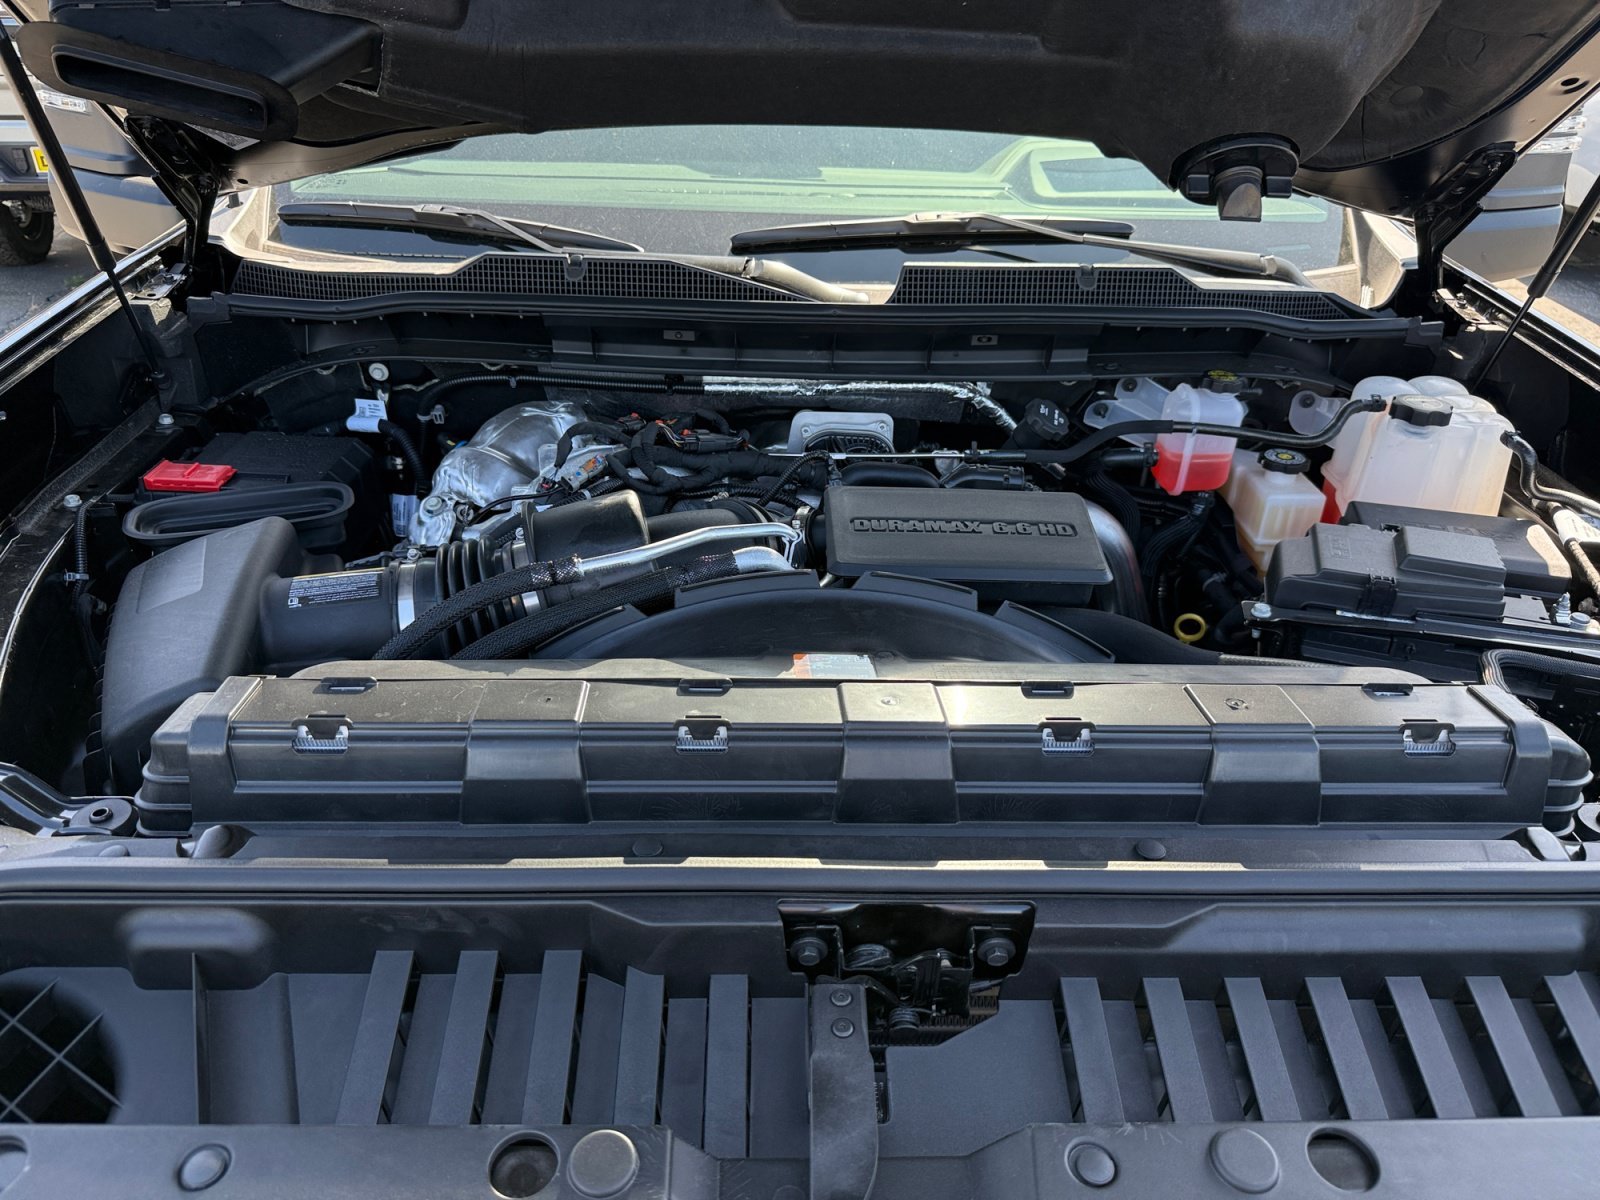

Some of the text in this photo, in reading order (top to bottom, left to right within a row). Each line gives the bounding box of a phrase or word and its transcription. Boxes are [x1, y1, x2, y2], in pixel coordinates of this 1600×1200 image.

[853, 519, 1075, 537] DURAMAX 6.6 HD
